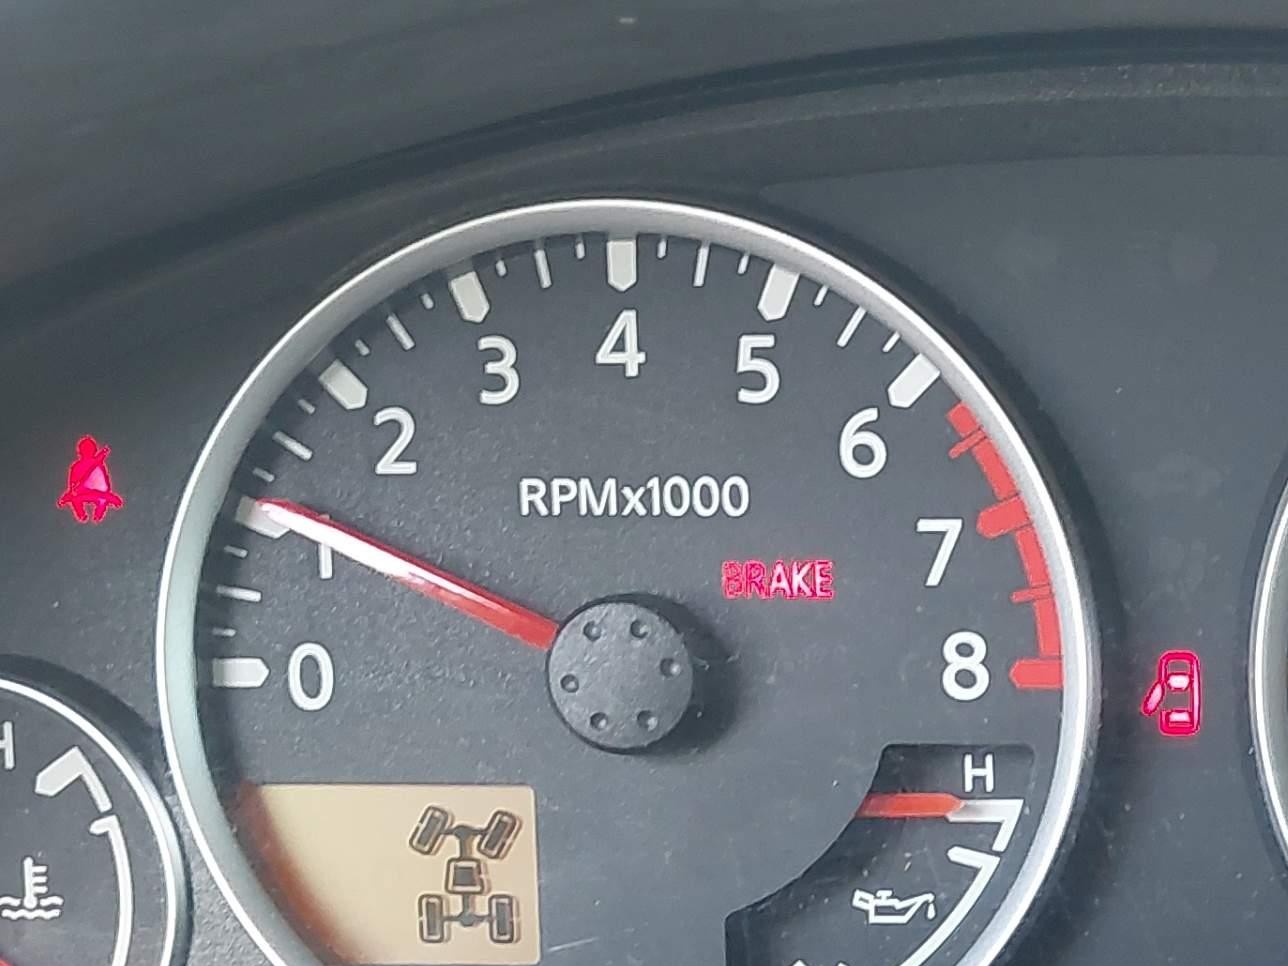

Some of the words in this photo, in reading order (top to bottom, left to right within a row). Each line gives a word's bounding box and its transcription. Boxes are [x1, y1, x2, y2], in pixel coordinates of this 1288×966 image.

[478, 335, 519, 405] 3
[595, 310, 646, 377] 4
[736, 334, 780, 404] 5
[374, 407, 417, 475] 2
[839, 408, 887, 478] 6
[519, 475, 750, 517] RPMx1000
[721, 561, 834, 600] BRAKE
[916, 518, 963, 587] 7
[287, 642, 335, 711] 0
[942, 631, 990, 701] 8
[963, 754, 995, 793] H
